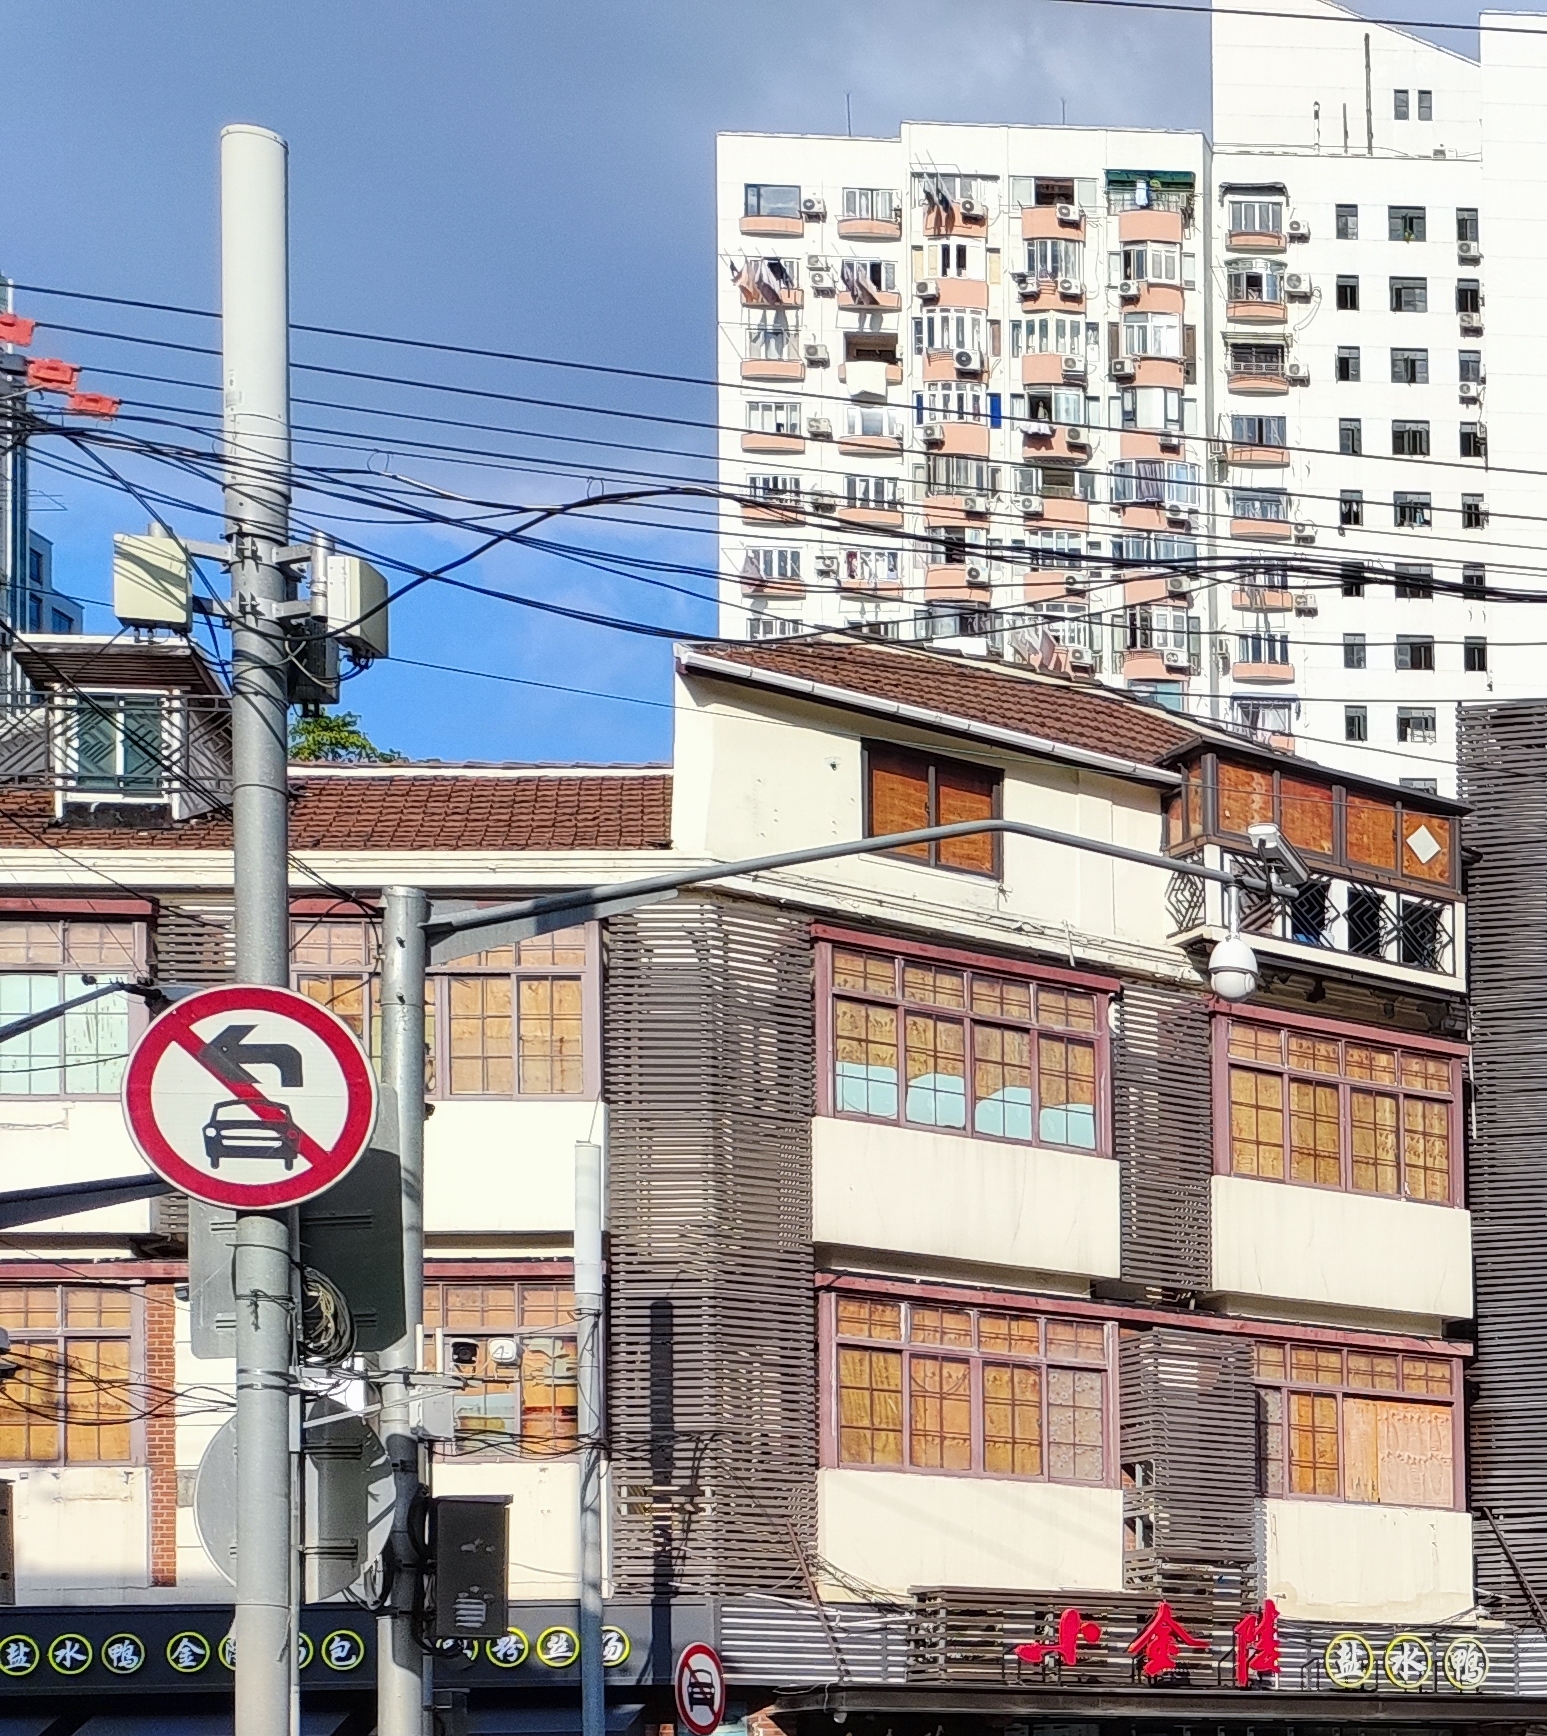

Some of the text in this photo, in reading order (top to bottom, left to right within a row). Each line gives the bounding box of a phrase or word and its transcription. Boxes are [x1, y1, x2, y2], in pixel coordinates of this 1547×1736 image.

[4, 1638, 140, 1670] 盐水鸭
[1013, 1599, 1282, 1688] 小金陵
[1334, 1640, 1485, 1681] 盐水鸭
